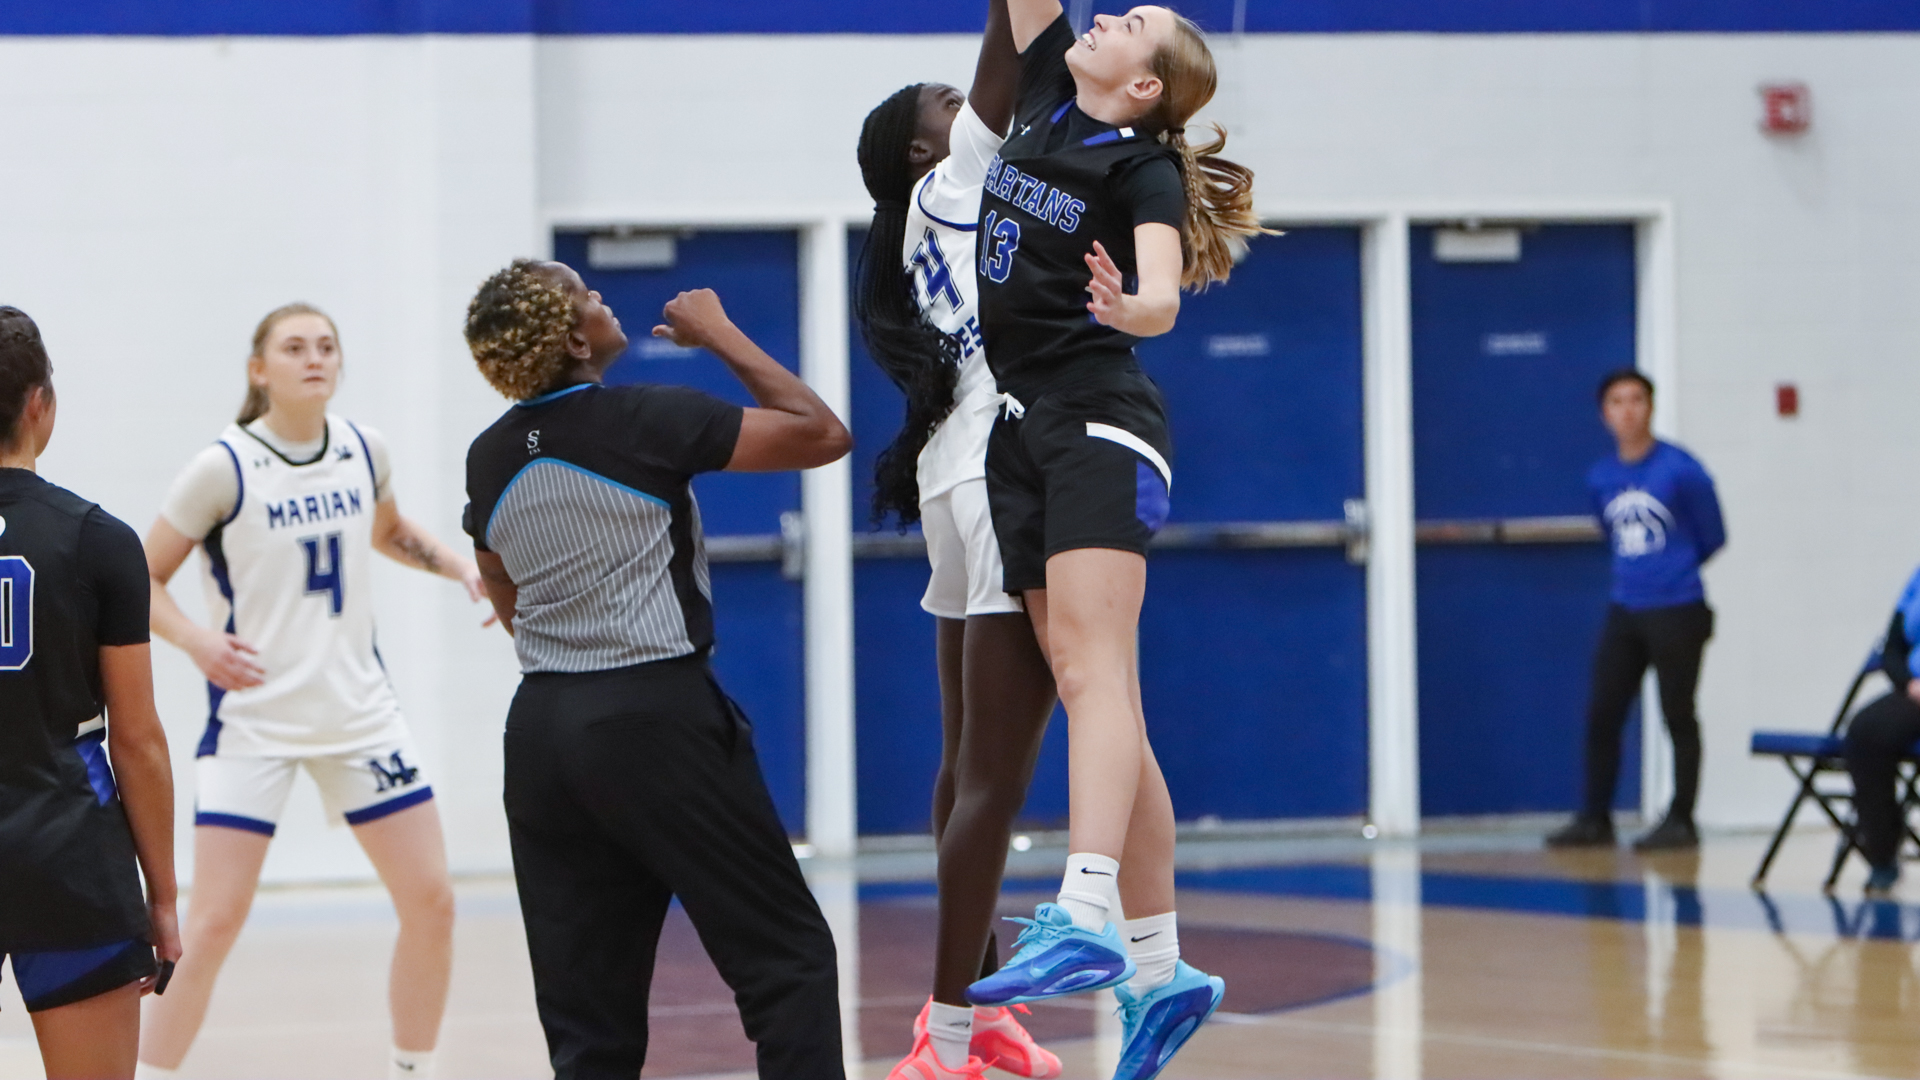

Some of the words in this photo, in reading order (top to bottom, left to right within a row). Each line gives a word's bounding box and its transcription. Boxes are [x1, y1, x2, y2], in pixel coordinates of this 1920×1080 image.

[980, 209, 1020, 283] 13
[266, 488, 362, 529] MARIAN
[297, 530, 346, 618] 4
